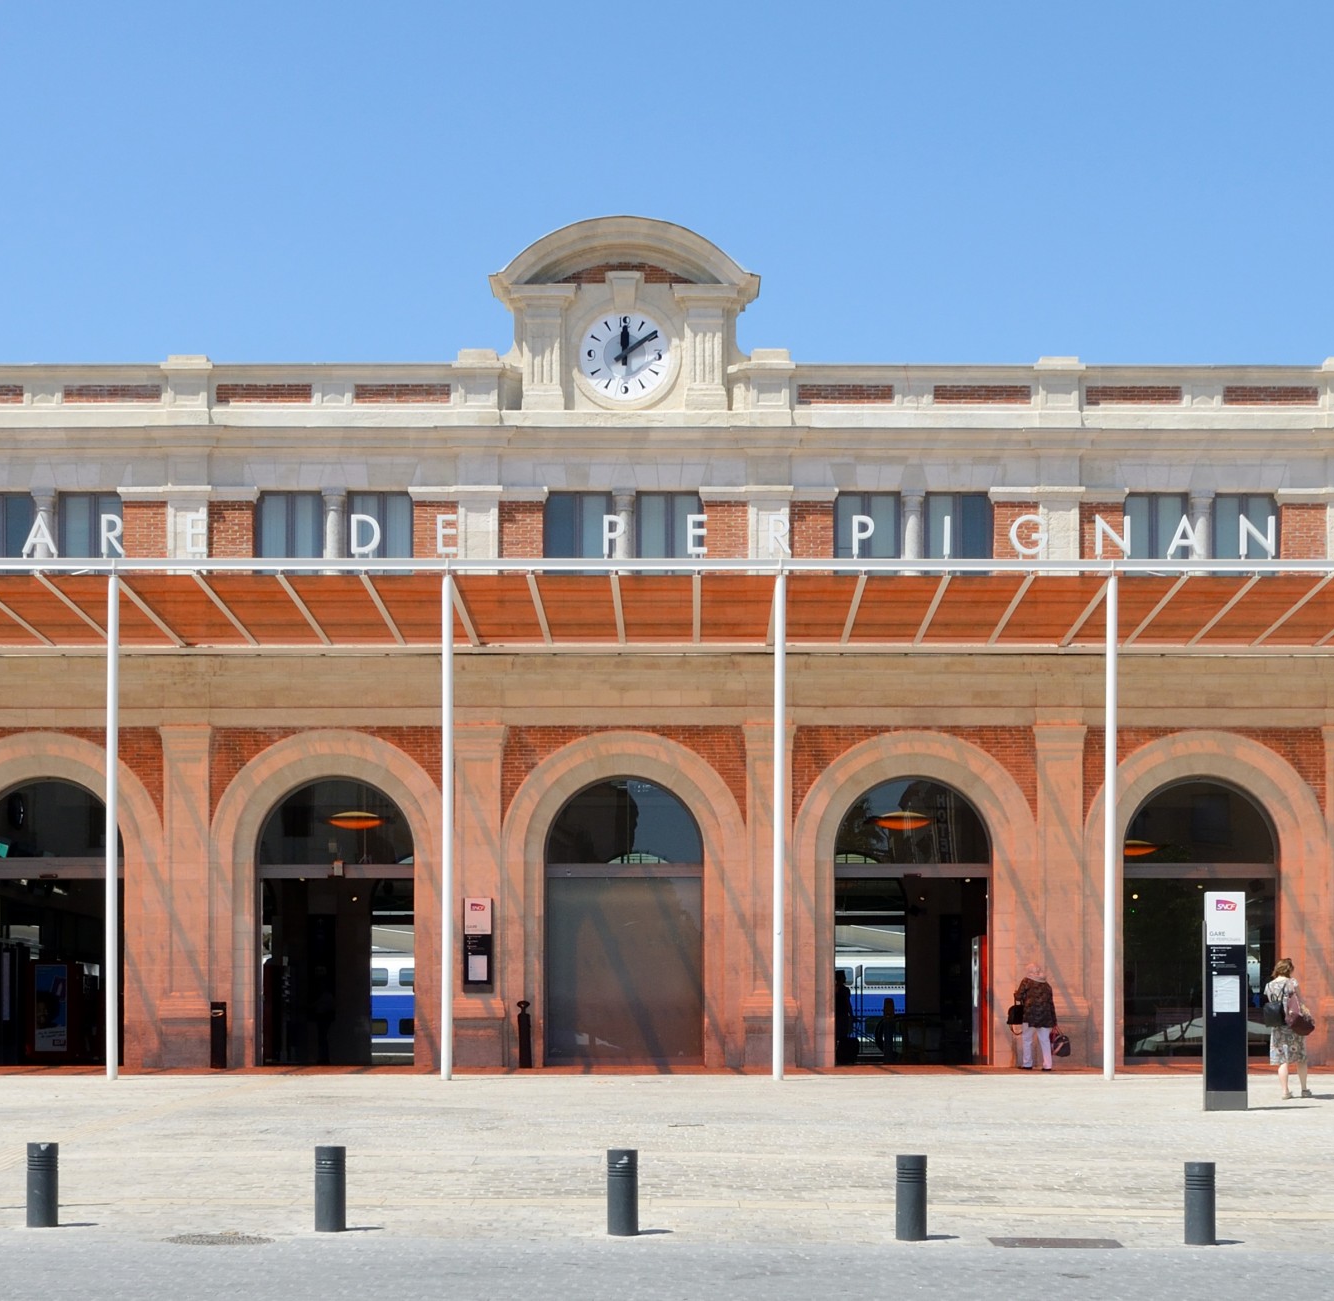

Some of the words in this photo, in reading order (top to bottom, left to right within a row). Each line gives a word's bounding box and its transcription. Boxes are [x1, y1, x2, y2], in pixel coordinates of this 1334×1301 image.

[587, 349, 596, 361] 9
[654, 349, 662, 361] 3
[620, 382, 629, 394] 6
[350, 514, 458, 554] DE
[602, 513, 1276, 556] PERPIGNAN
